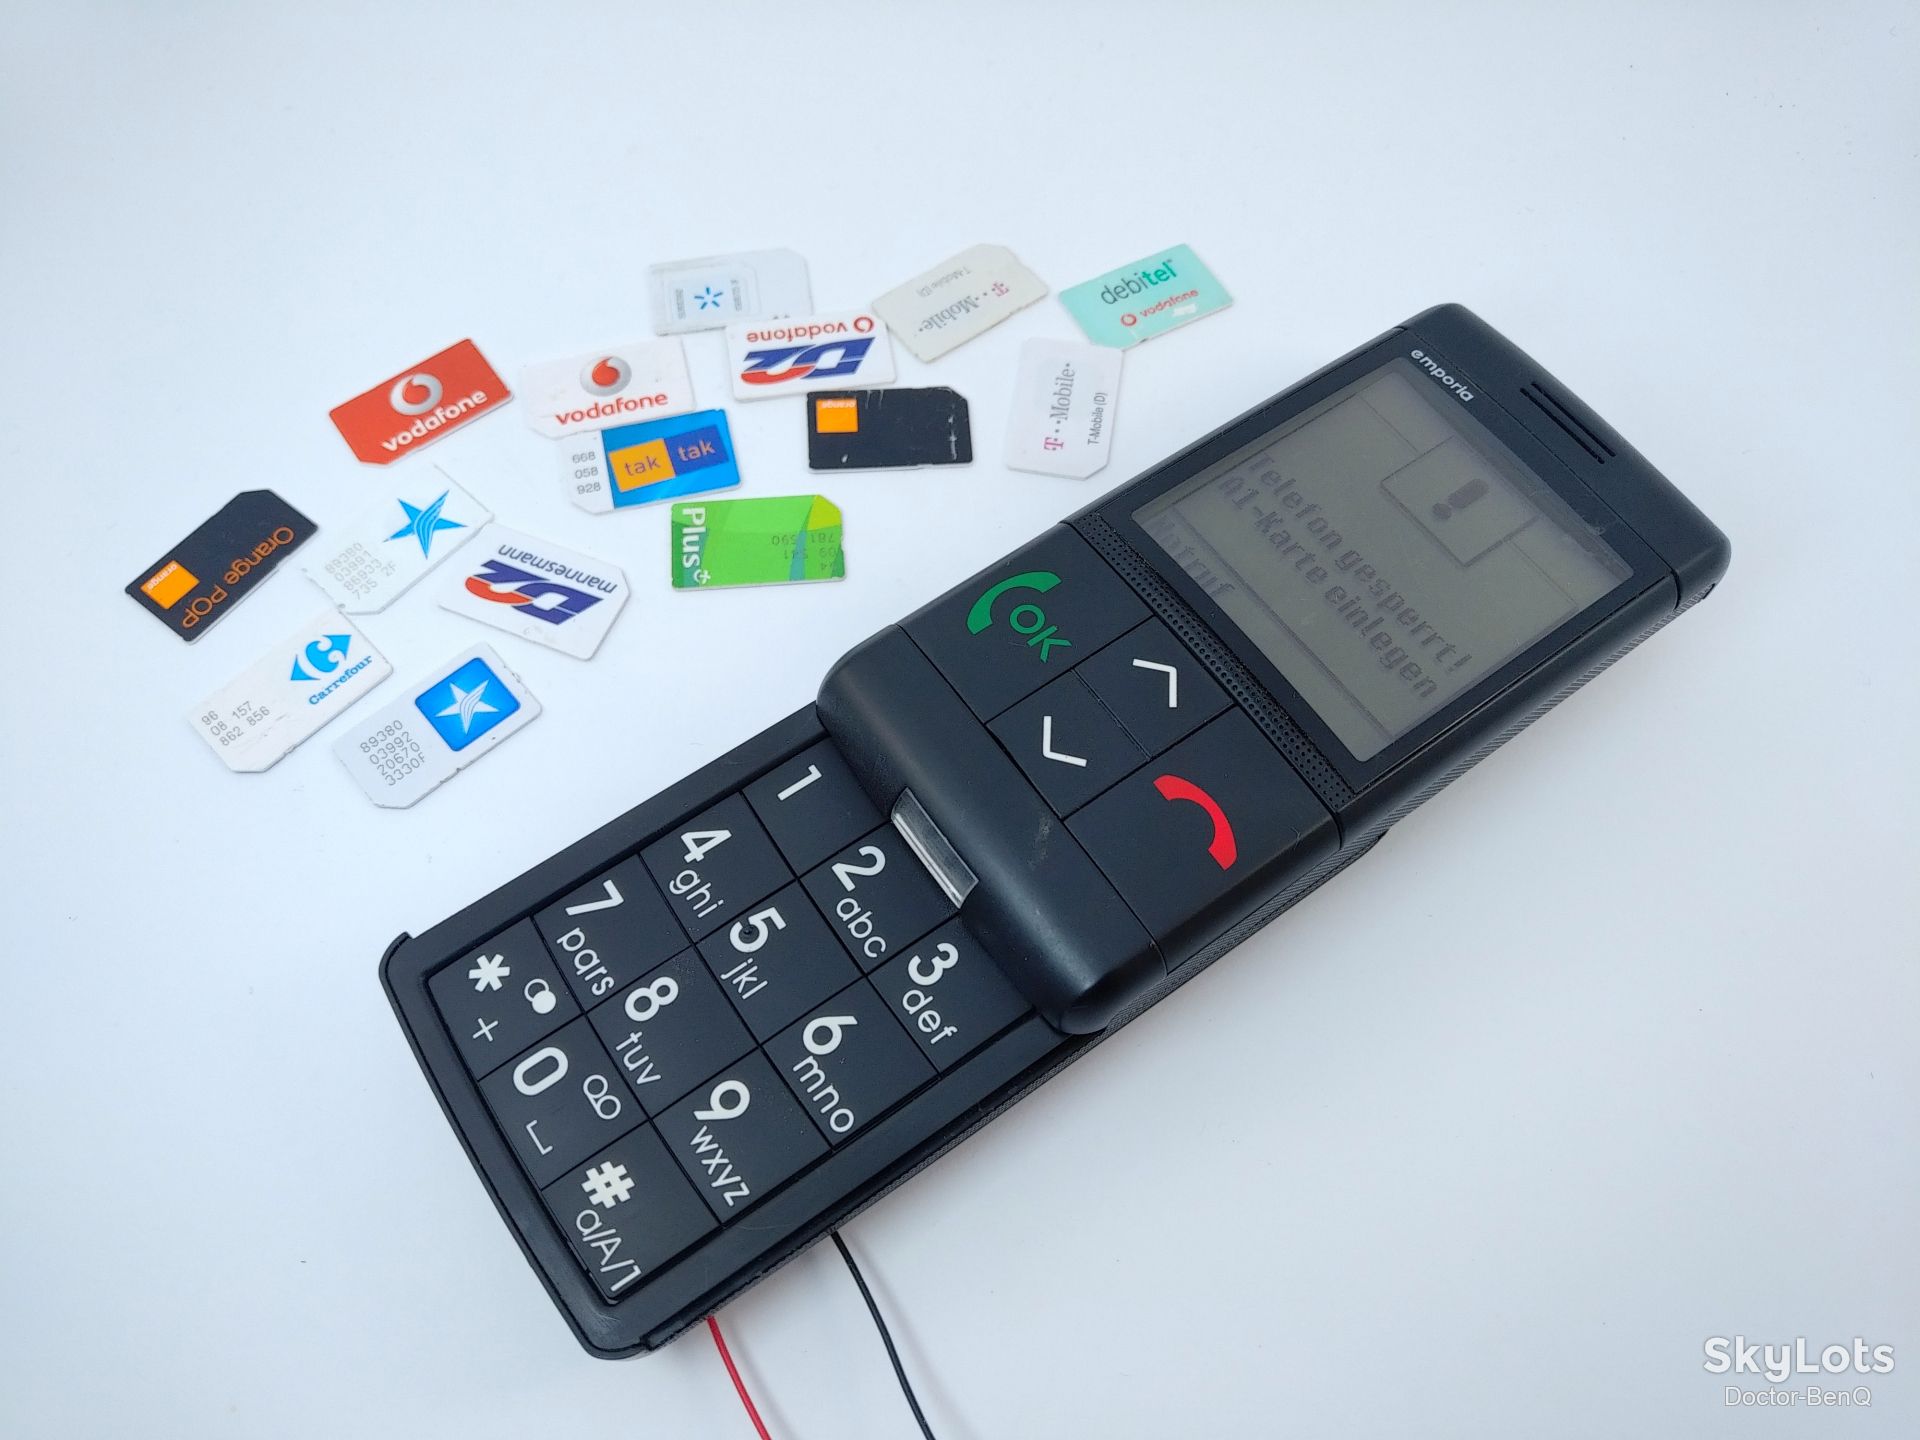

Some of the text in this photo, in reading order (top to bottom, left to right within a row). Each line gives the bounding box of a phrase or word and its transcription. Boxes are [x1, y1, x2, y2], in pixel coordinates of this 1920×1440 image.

[1099, 261, 1177, 305] debitel
[1139, 288, 1199, 318] vodafone
[746, 320, 849, 343] vodafone
[1410, 348, 1475, 403] emporia
[381, 389, 488, 452] vodafone
[555, 391, 669, 426] vodafone
[574, 466, 599, 480] 058
[624, 438, 716, 478] tak tak
[576, 481, 602, 496] 928
[1245, 452, 1344, 554] Telefon
[682, 506, 706, 569] Plus
[181, 525, 294, 629] Orange POP
[498, 543, 618, 594] mannesmann
[1009, 604, 1073, 663] OK
[1324, 580, 1439, 699] einlegen
[308, 654, 373, 706] Carrefour
[201, 710, 219, 726] 96
[210, 700, 254, 737] 08 157
[219, 705, 271, 747] 862 856
[360, 719, 403, 753] 89380
[369, 731, 413, 765] 03992
[376, 741, 420, 776] 20670
[384, 751, 425, 787] 3330F
[777, 764, 822, 801] 1
[680, 829, 733, 864] 4
[831, 845, 886, 892] 2
[565, 879, 624, 916] 7
[668, 868, 725, 920] ghi
[729, 906, 787, 953] 5
[836, 896, 887, 959] abc
[556, 926, 616, 997] pqrs
[720, 957, 769, 1000] jkl
[907, 942, 959, 986] 3
[624, 976, 679, 1023] 8
[902, 988, 958, 1045] def
[802, 1015, 858, 1056] 6
[615, 1031, 662, 1086] tuv
[693, 1080, 751, 1122] 9
[792, 1055, 855, 1134] mno
[580, 1160, 636, 1210] #
[690, 1125, 751, 1208] wxyz
[575, 1208, 643, 1293] a/A/1
